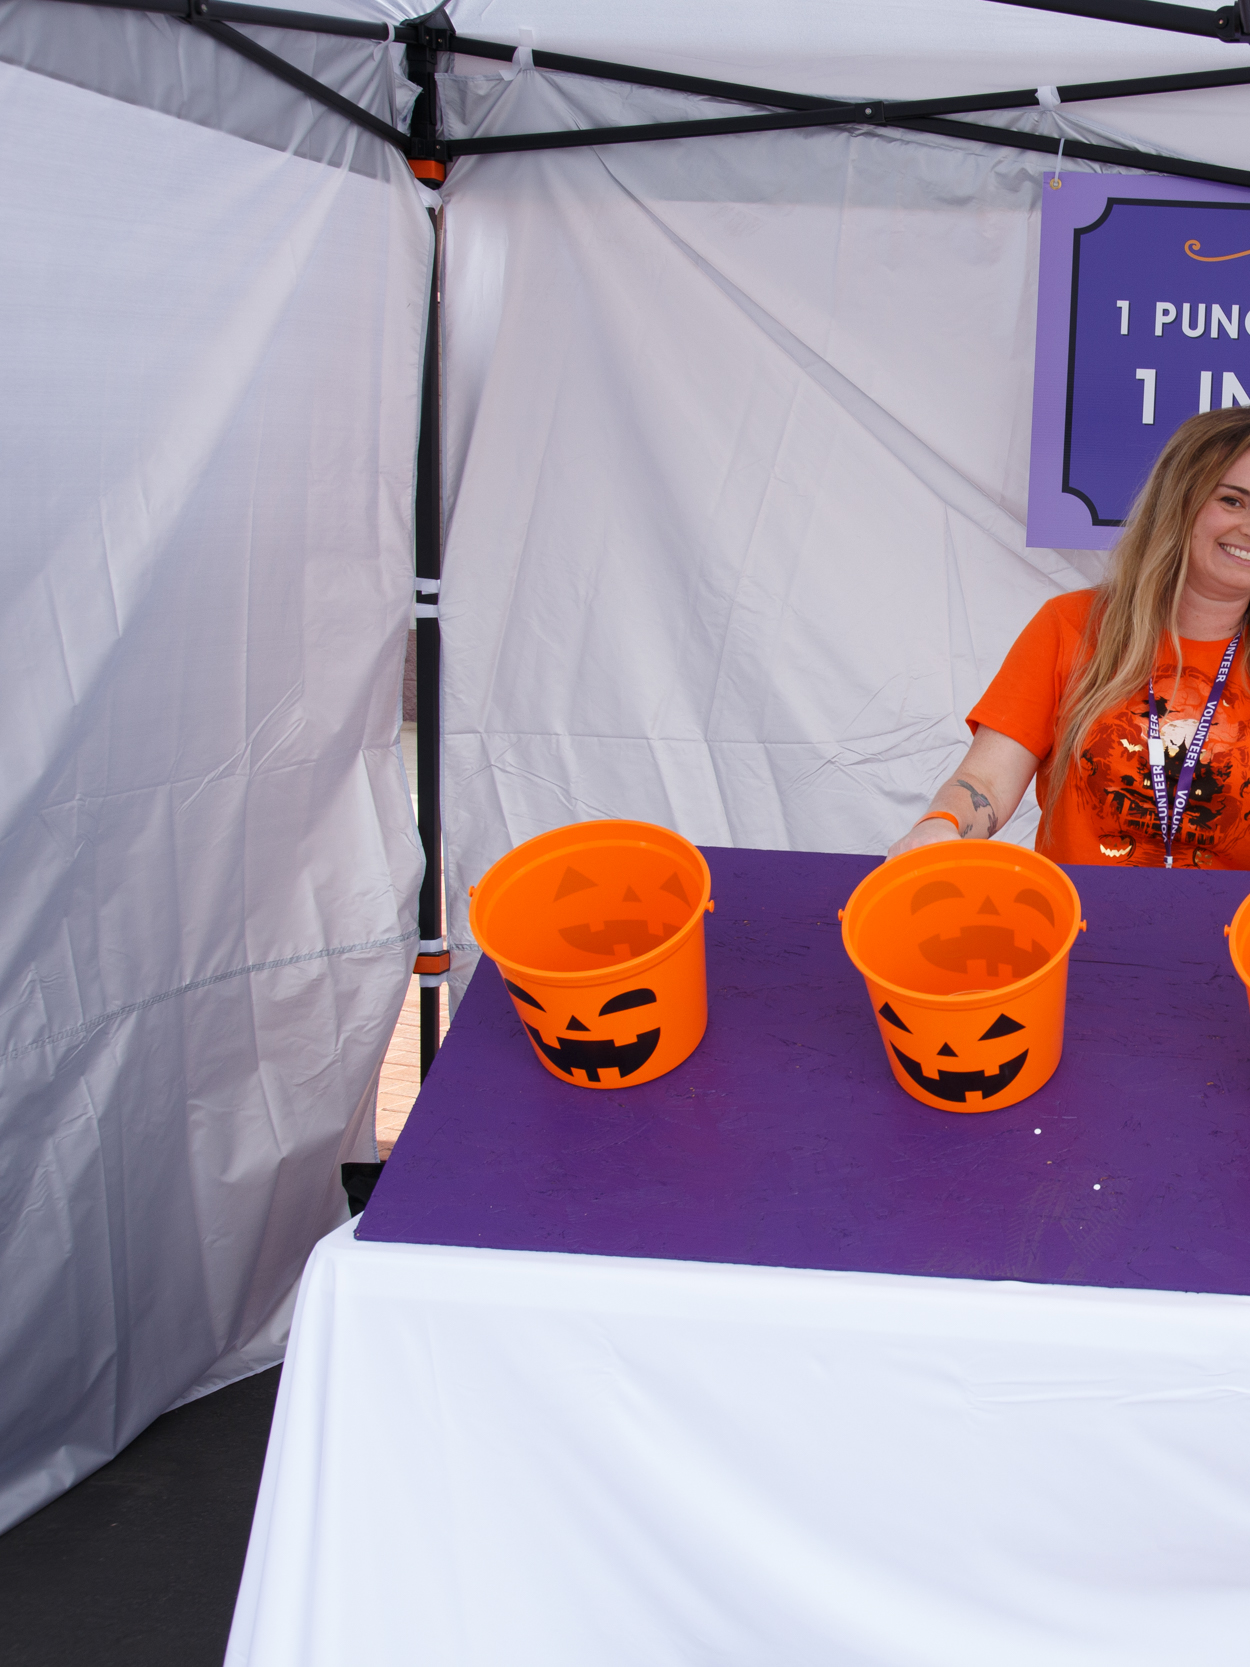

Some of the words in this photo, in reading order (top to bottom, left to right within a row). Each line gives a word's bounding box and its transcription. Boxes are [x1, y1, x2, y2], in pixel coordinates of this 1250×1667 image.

[1116, 300, 1130, 336] 1
[1136, 368, 1157, 425] 1
[1184, 701, 1217, 767] VOLUNTEER
[1153, 766, 1167, 843] VOLUNTEER
